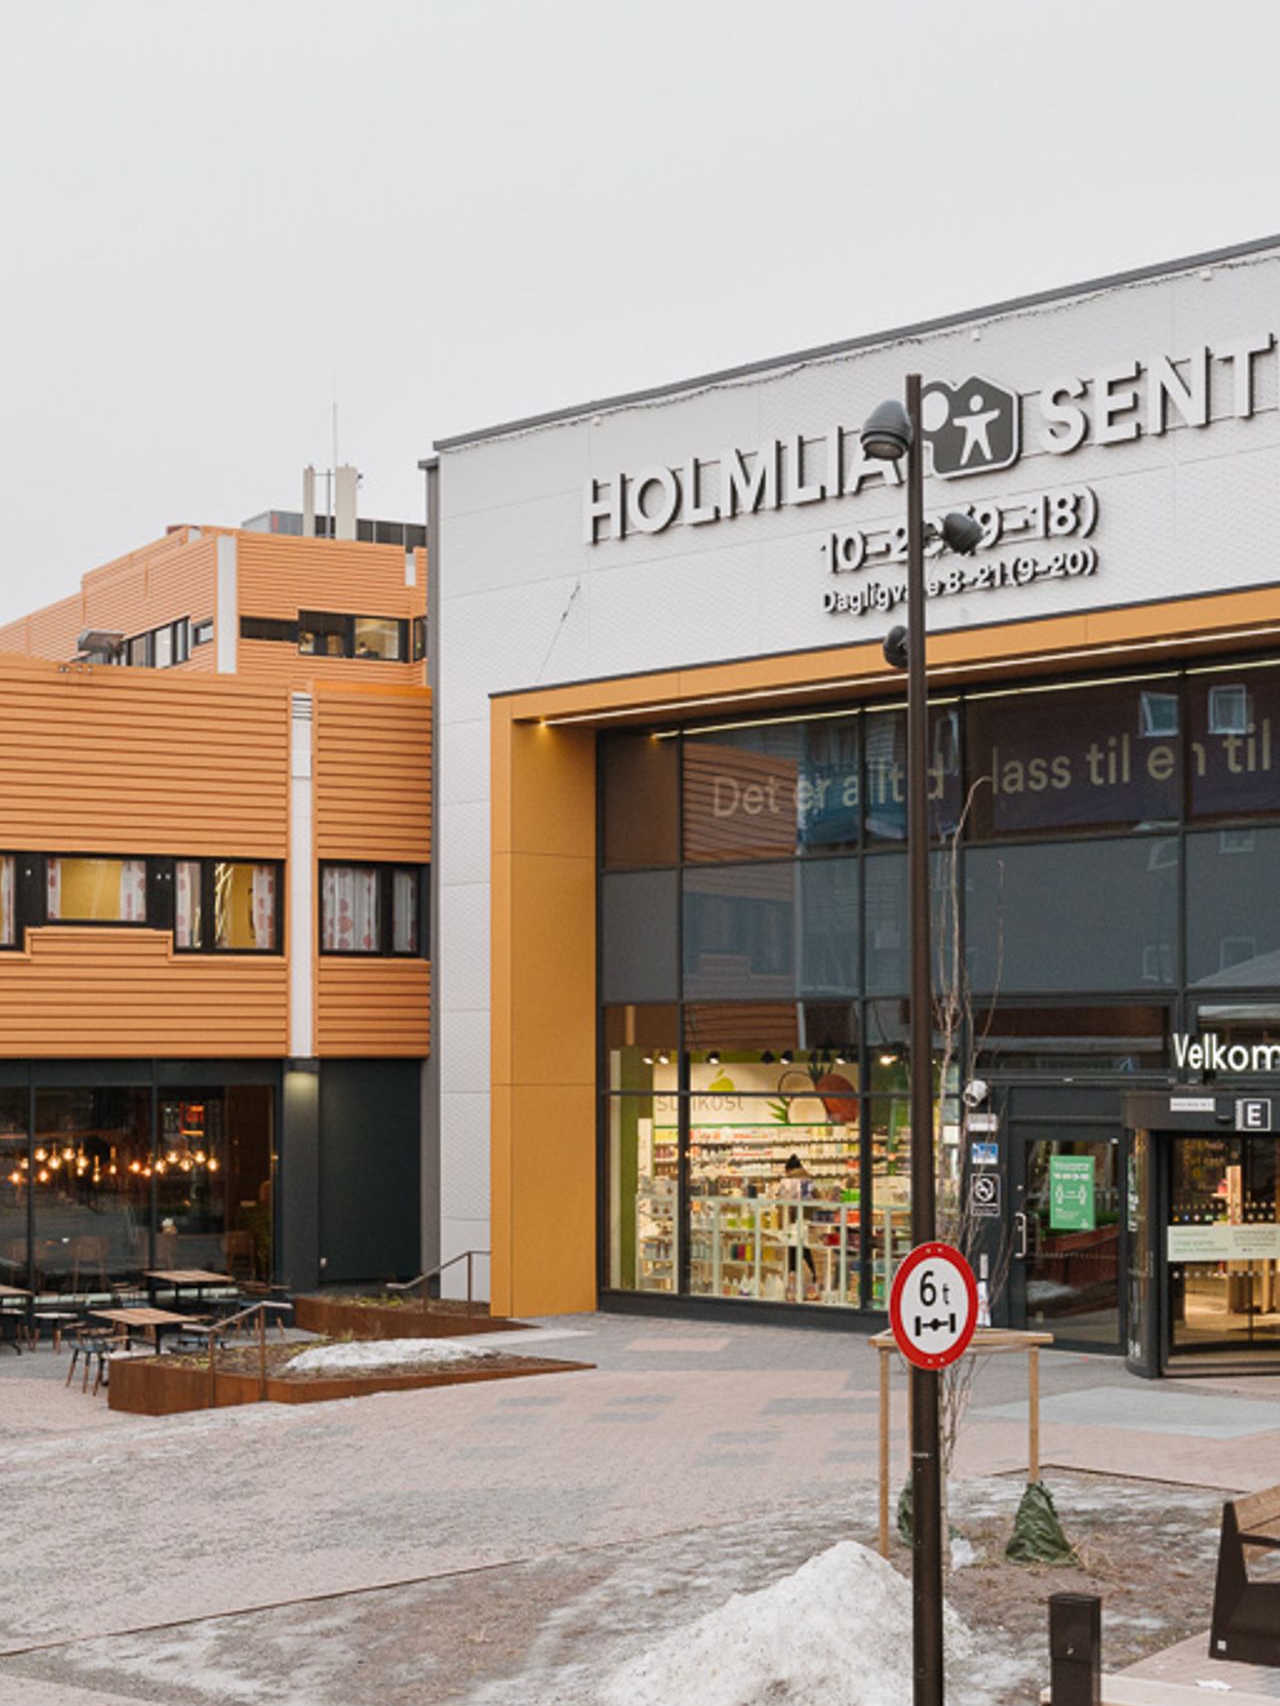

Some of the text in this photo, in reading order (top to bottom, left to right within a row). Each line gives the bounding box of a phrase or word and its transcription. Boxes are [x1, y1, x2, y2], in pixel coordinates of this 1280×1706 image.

[821, 578, 945, 616] Dagligve
[711, 774, 780, 818] Det
[793, 775, 832, 811] er
[966, 747, 1071, 797] lass
[1085, 733, 1131, 786] til
[1222, 718, 1272, 774] til
[1246, 1103, 1262, 1127] E
[920, 1270, 950, 1307] 6 t
